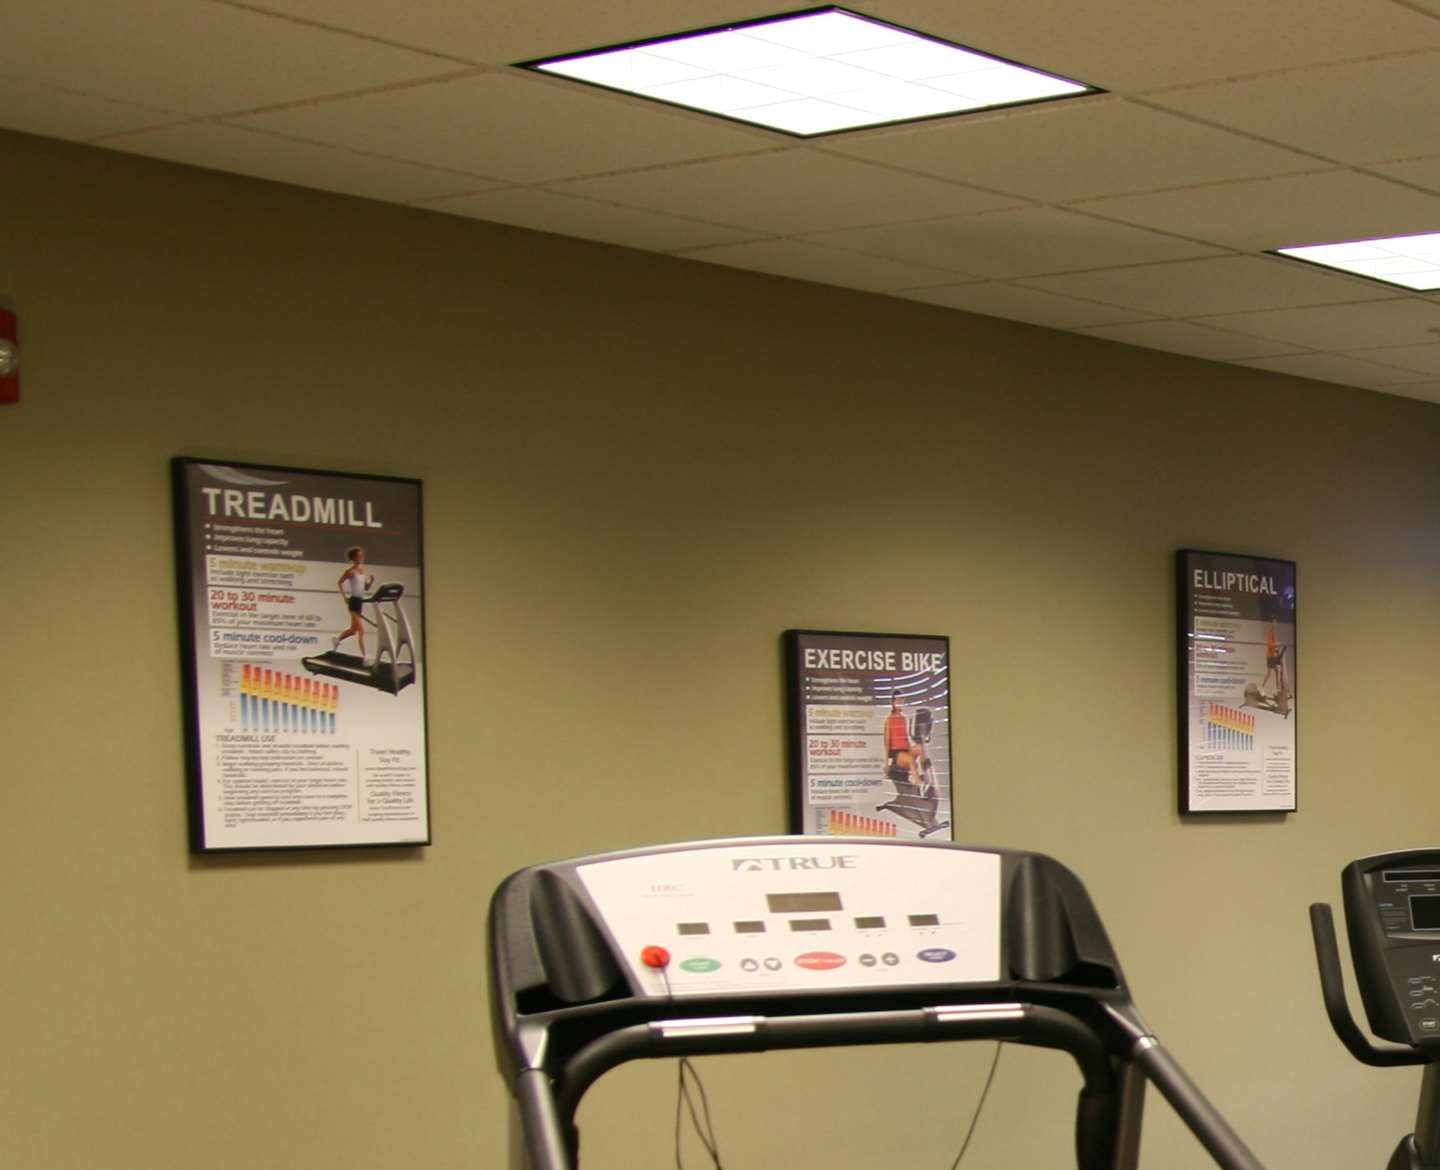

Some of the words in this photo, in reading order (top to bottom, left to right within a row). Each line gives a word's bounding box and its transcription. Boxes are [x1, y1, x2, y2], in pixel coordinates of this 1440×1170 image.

[202, 487, 382, 528] TREADMILL
[1194, 569, 1278, 595] ELLIPTICAL
[210, 590, 225, 601] 20
[227, 592, 239, 601] to
[241, 592, 255, 601] 30
[257, 593, 295, 604] minute
[211, 601, 257, 611] workout
[213, 630, 220, 641] 5
[223, 632, 260, 642] minute
[804, 648, 896, 671] EXERCISE
[901, 651, 942, 673] BIKE
[763, 855, 860, 871] TRUE
